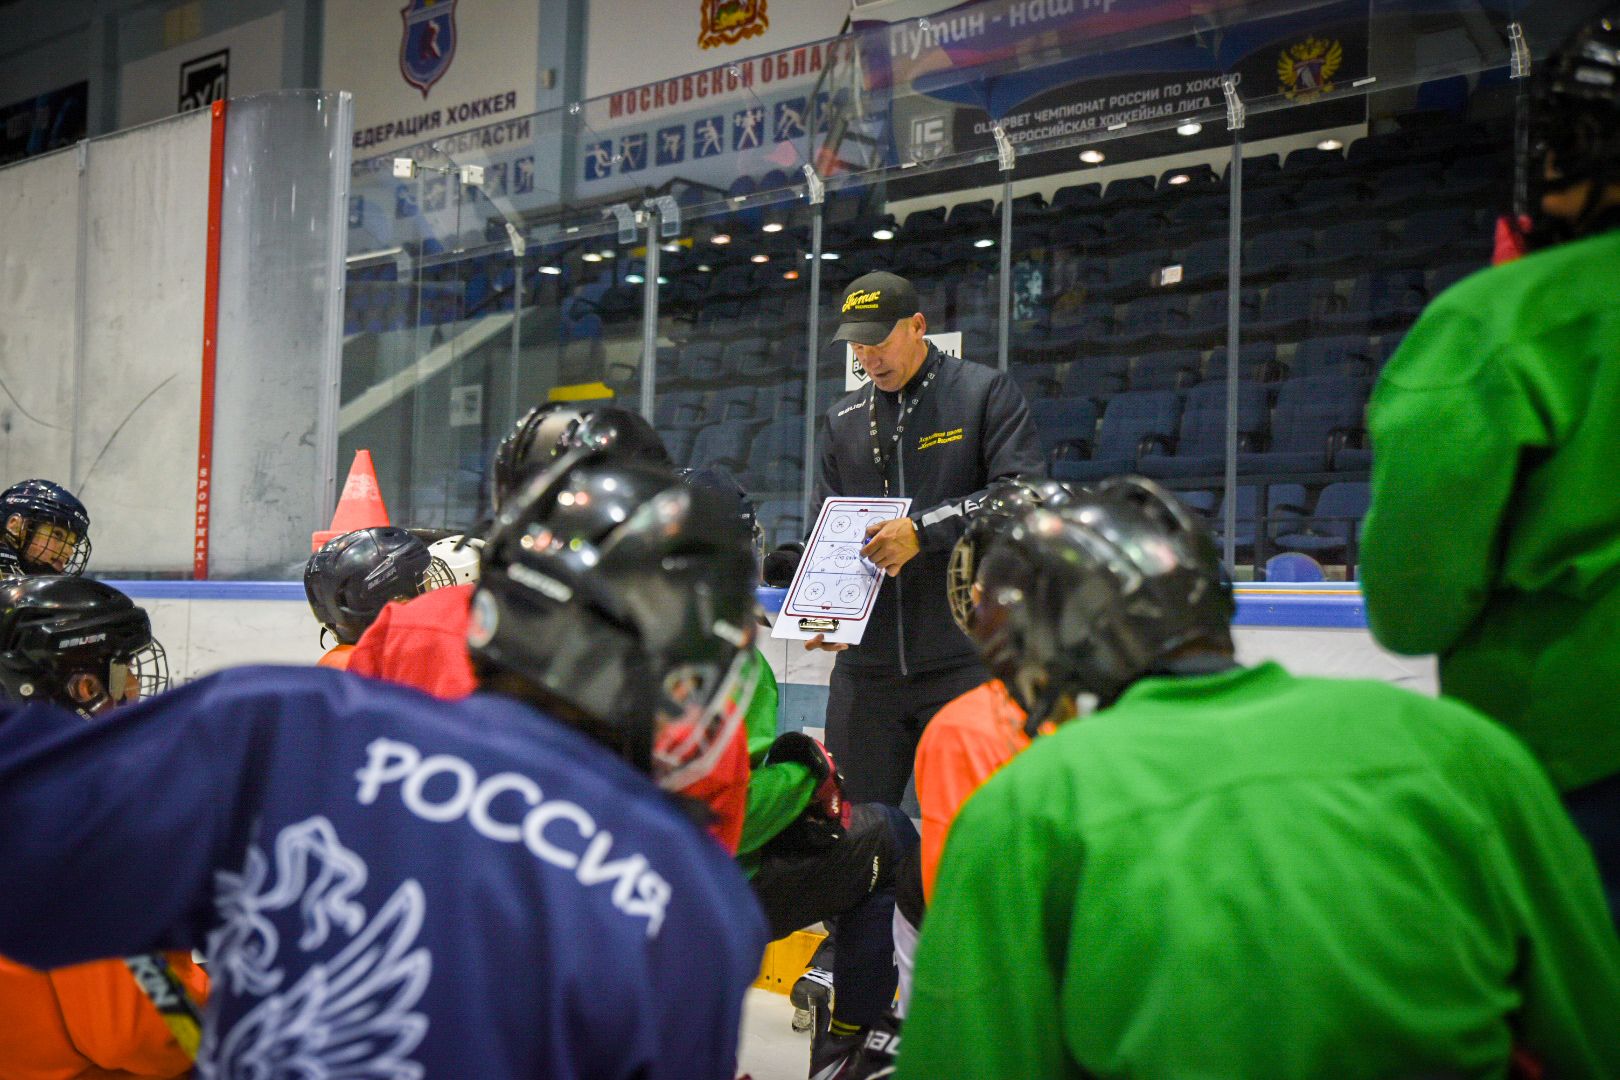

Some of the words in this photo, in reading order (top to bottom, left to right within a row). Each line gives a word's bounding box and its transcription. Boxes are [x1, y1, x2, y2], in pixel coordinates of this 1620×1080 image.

[352, 110, 441, 148] ЕДЕРАЦИЯ
[446, 91, 517, 125] ХОККЕЯ
[1034, 98, 1106, 123] ЧЕМПИОНАТ
[1109, 88, 1160, 109] РОССИИ
[1163, 84, 1182, 98] ПО
[1177, 96, 1211, 114] ЛИГА
[355, 737, 672, 939] РОССИЯ
